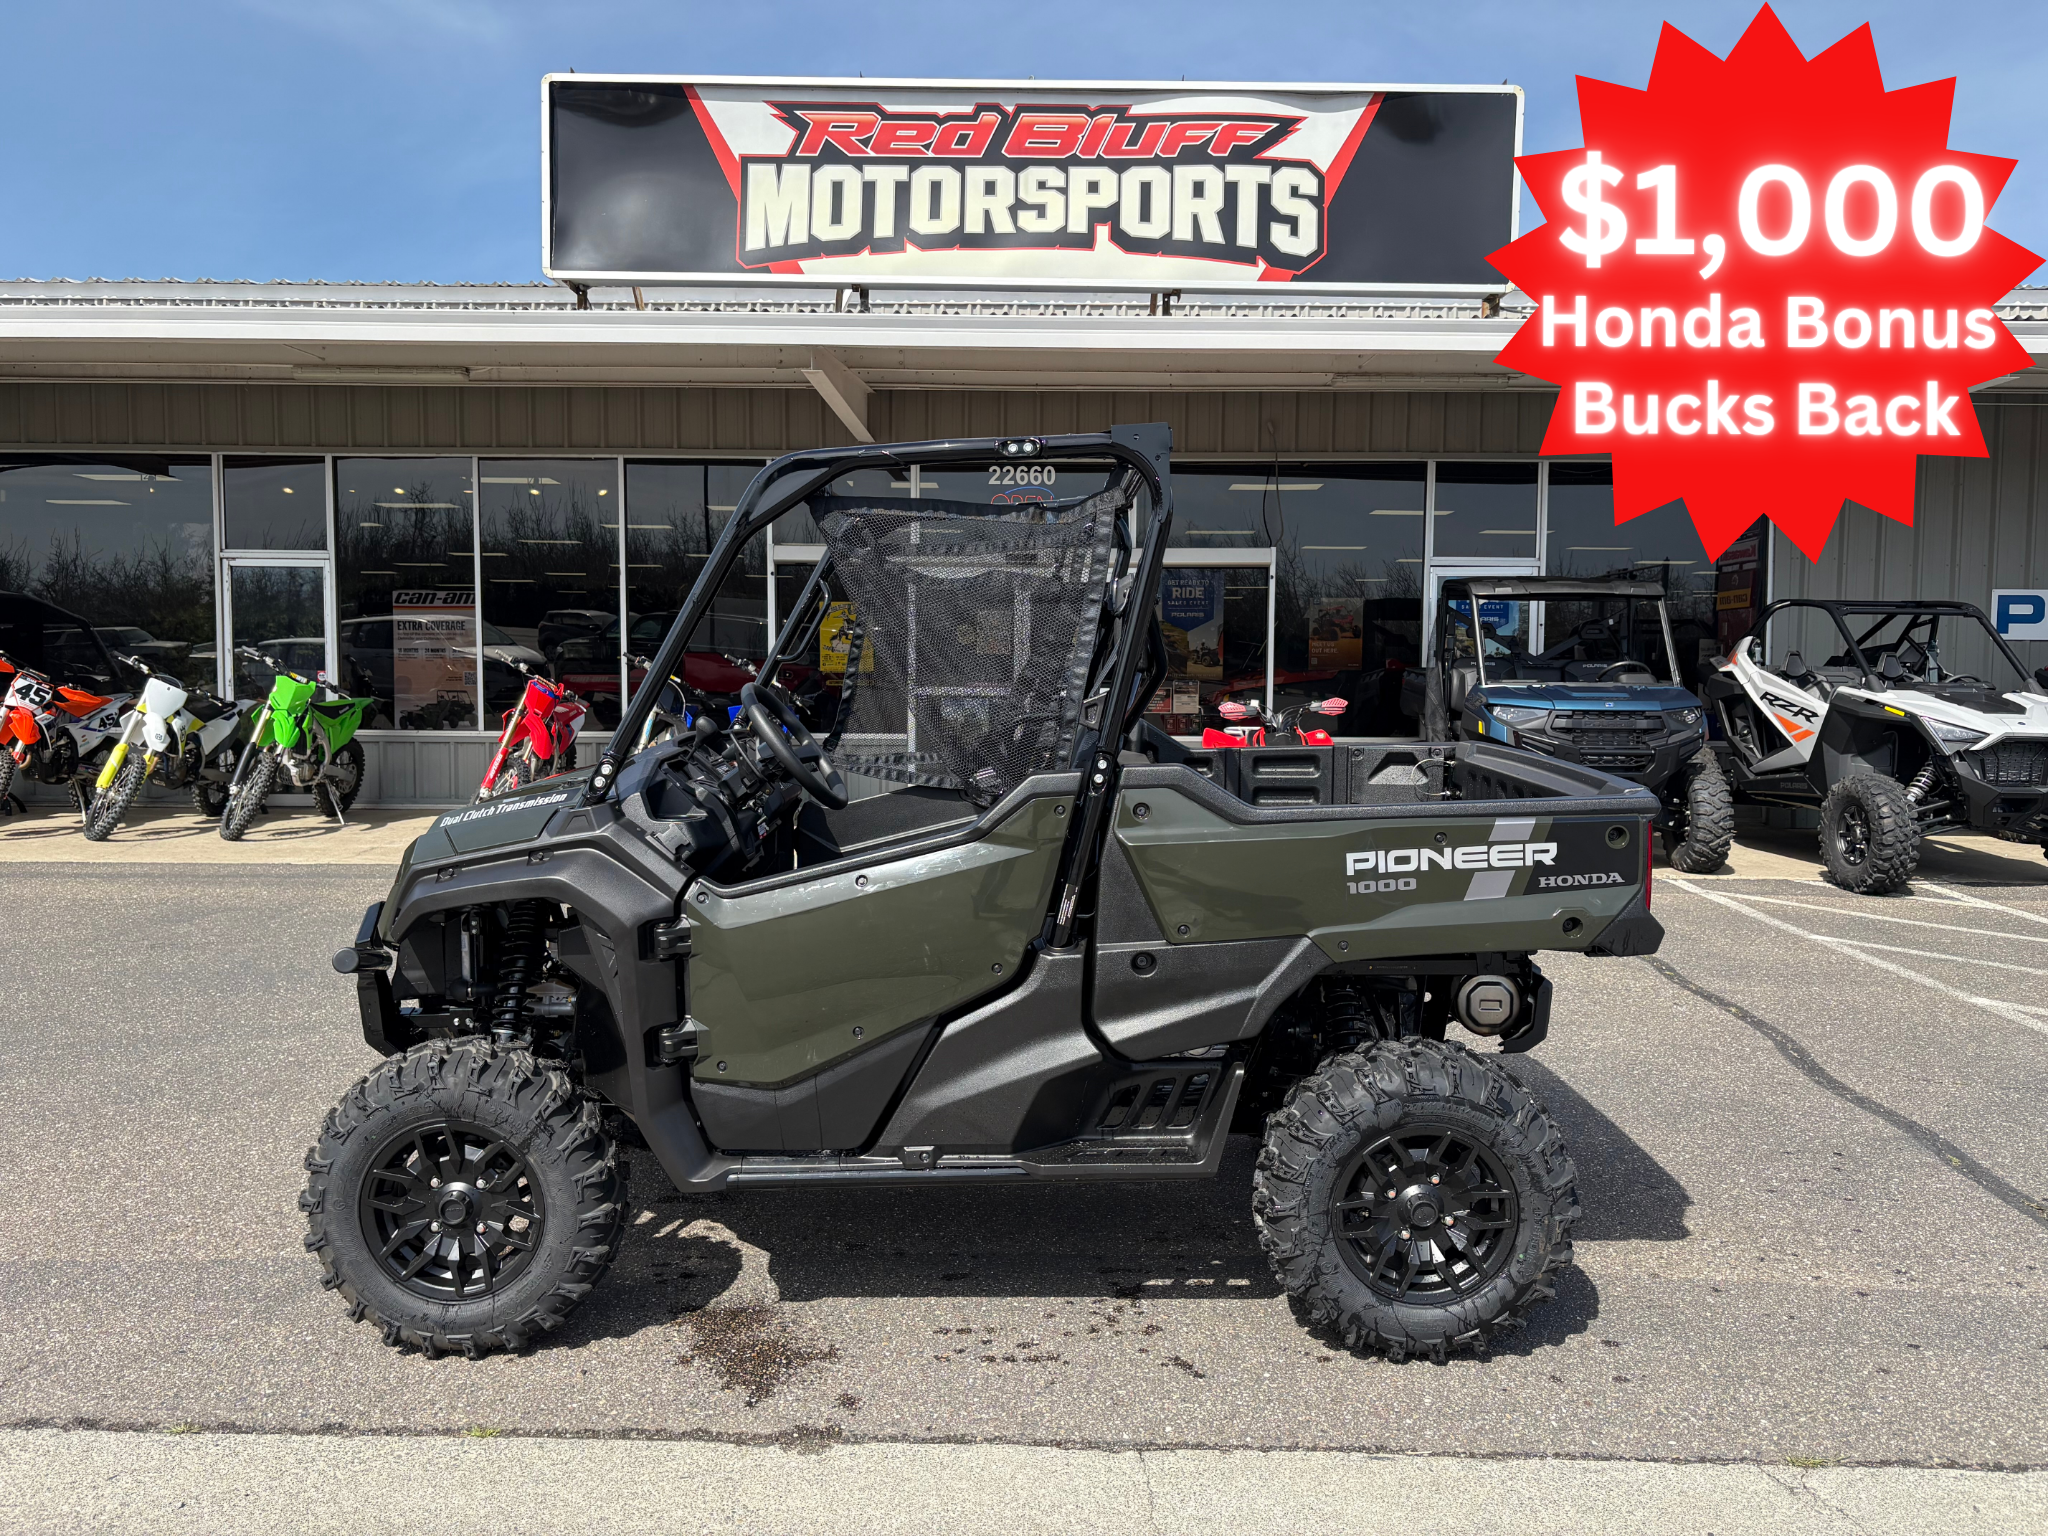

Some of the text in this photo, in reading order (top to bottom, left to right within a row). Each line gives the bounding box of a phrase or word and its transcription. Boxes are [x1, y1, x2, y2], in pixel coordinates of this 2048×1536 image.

[798, 113, 1000, 159] Red
[744, 163, 1321, 260] MOTORSPORTS
[988, 465, 1056, 486] 22660
[1172, 587, 1205, 599] RIDE
[397, 620, 466, 631] EXTRA COVERAGE
[1998, 594, 2046, 635] P
[14, 683, 52, 707] 45
[1759, 691, 1820, 724] RZR
[440, 793, 568, 828] Dual Clutch Transmission
[1345, 841, 1558, 876] PIONEER
[1346, 877, 1417, 894] 1000
[1538, 870, 1625, 888] HONDA
